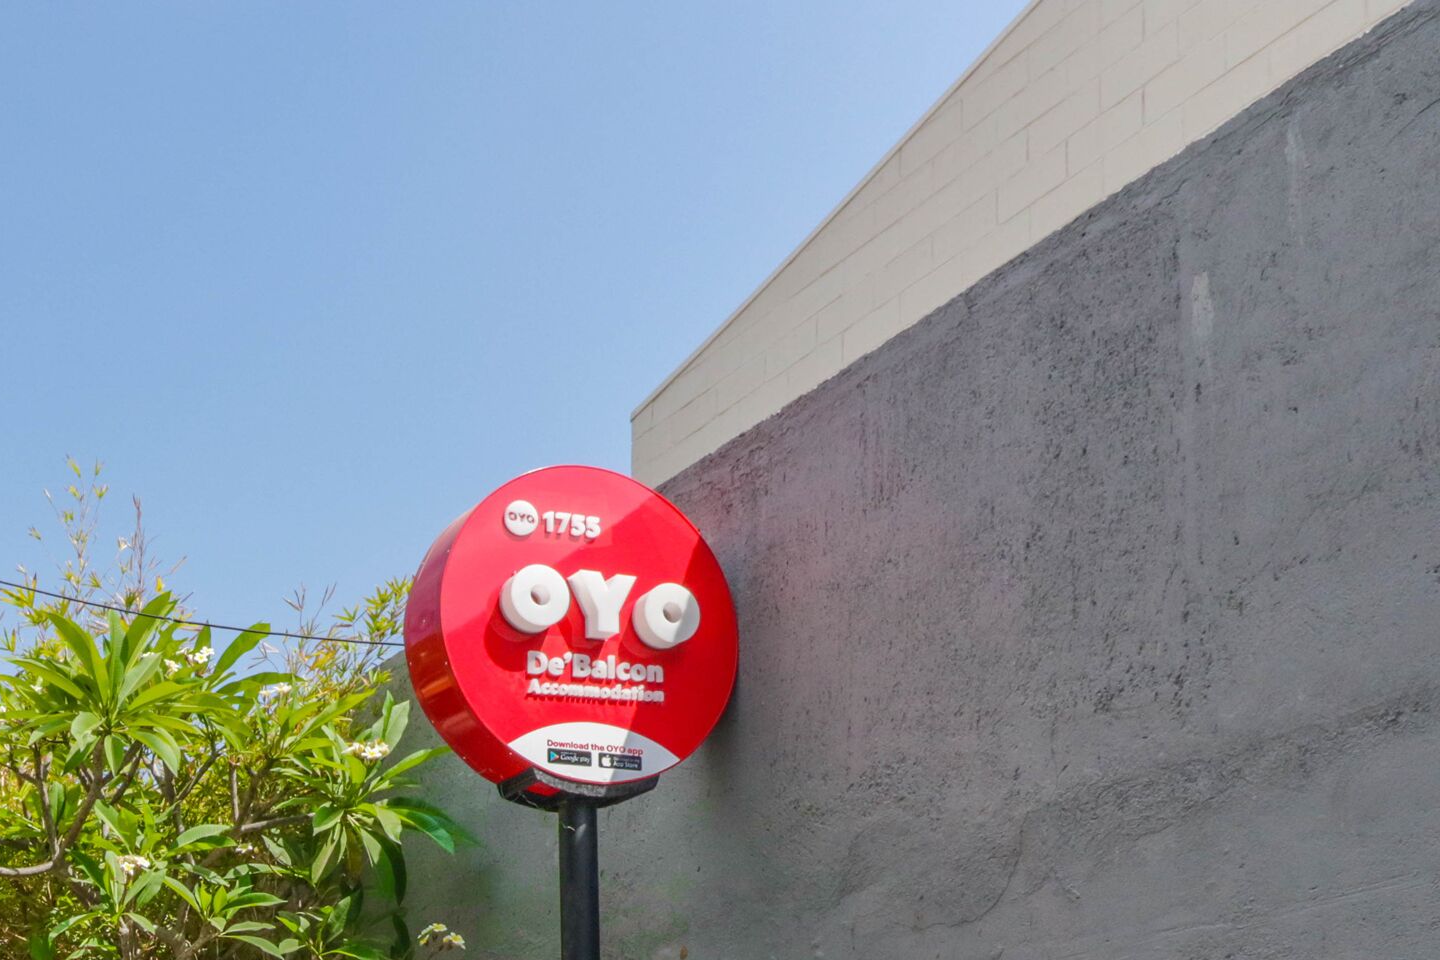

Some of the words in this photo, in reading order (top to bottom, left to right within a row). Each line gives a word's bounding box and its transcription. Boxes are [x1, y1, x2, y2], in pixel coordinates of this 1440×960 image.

[508, 511, 535, 524] OYO
[542, 511, 601, 539] 1755
[499, 563, 701, 649] OYO
[526, 649, 664, 684] De'Balcon
[526, 677, 665, 703] Accommodation
[546, 739, 589, 751] Download
[591, 743, 605, 752] the
[606, 744, 626, 754] OYO
[627, 747, 644, 757] app
[560, 752, 580, 763] Google
[612, 759, 624, 769] App
[624, 760, 639, 769] Store
